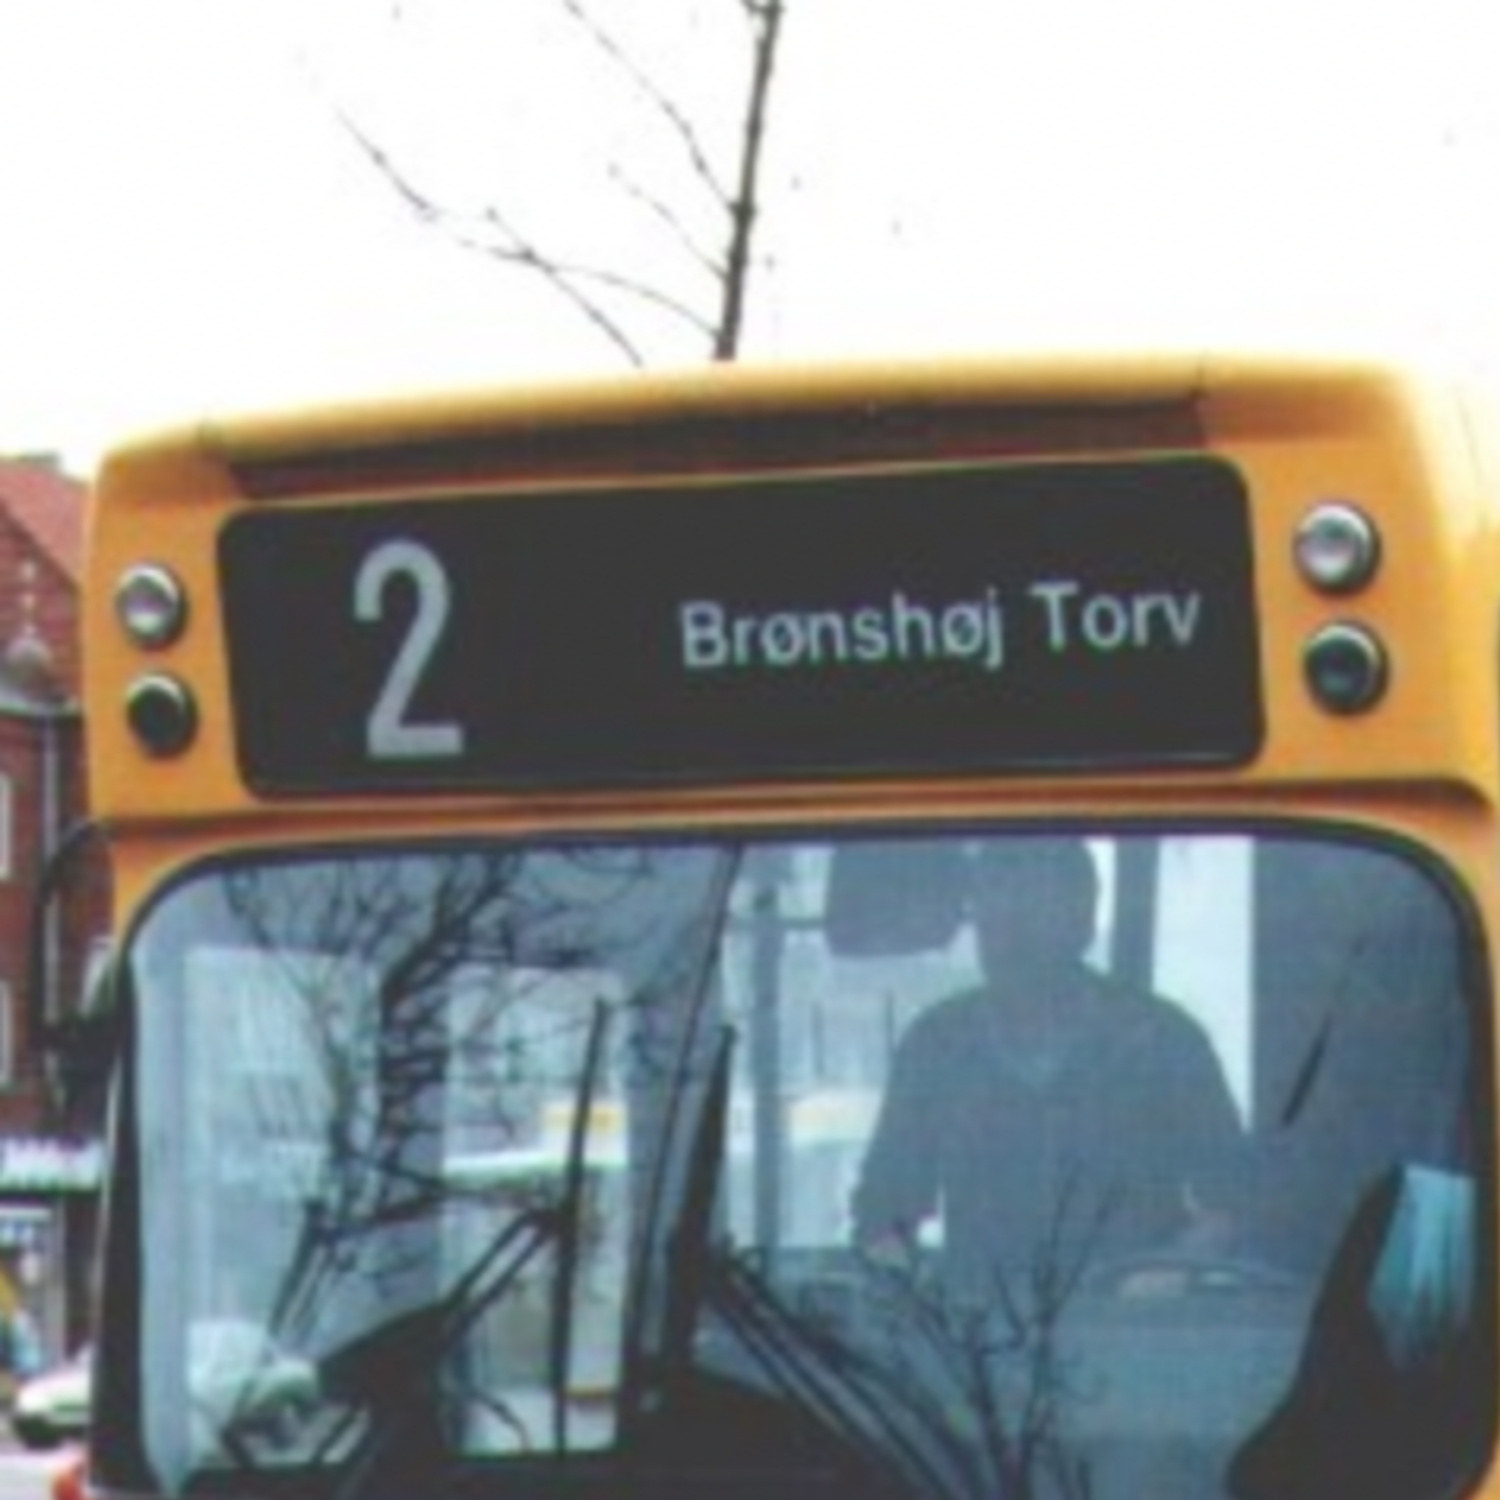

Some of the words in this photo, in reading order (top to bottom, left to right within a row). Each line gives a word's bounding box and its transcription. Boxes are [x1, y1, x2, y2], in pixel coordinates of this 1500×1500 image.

[352, 537, 464, 758] 2
[679, 586, 1003, 671] Brønshøj
[1030, 580, 1202, 652] Torv
